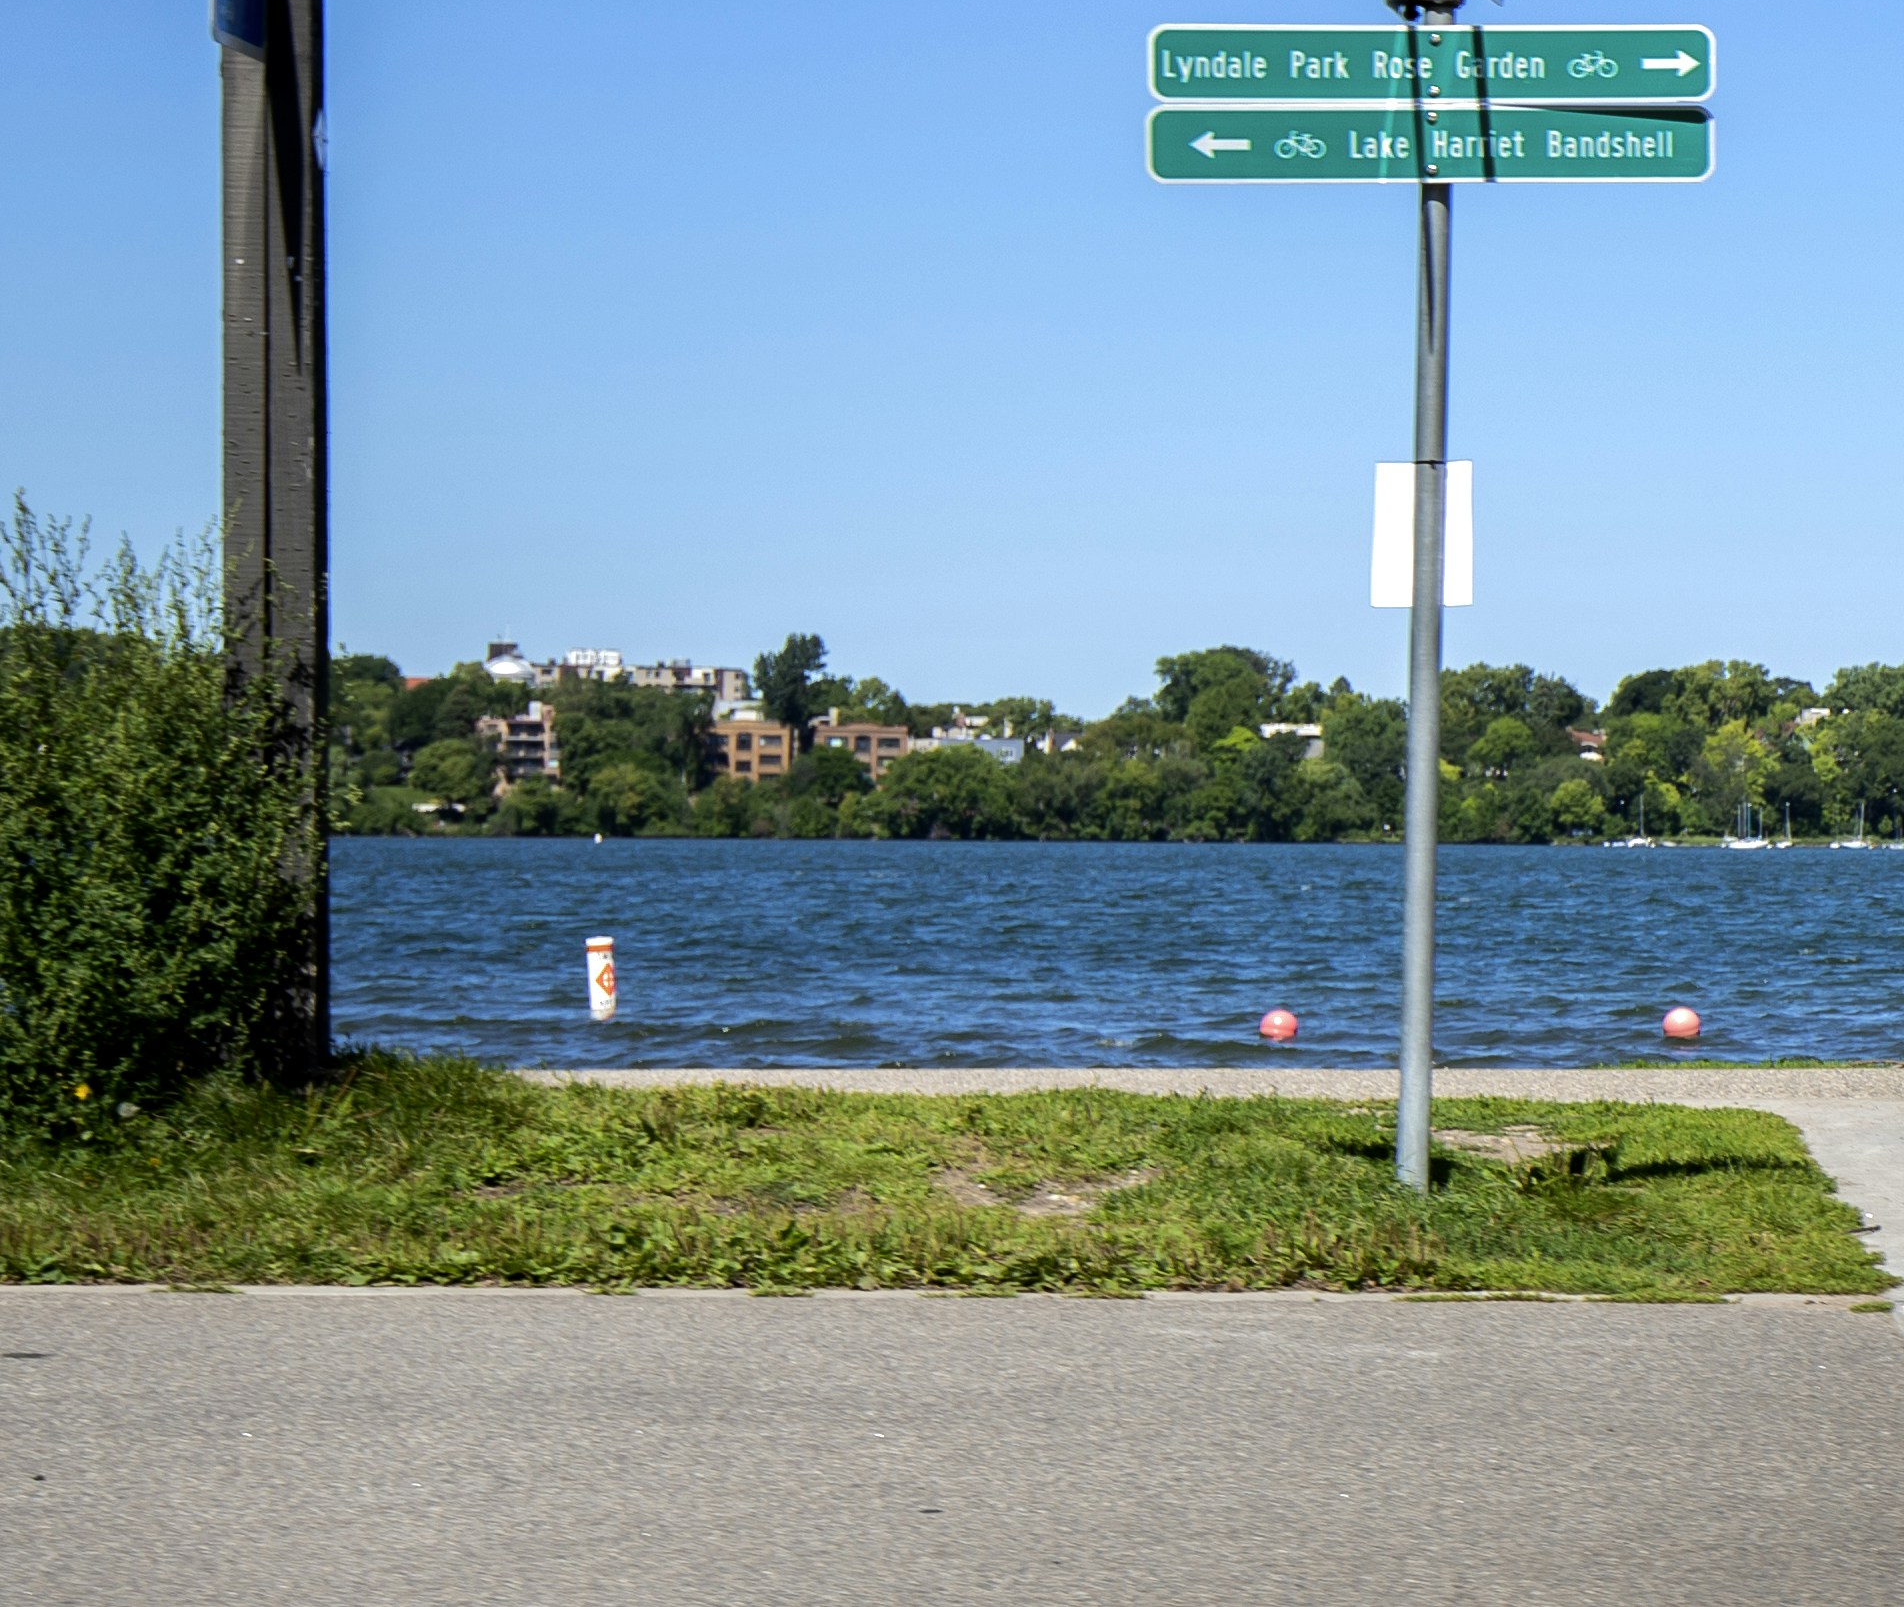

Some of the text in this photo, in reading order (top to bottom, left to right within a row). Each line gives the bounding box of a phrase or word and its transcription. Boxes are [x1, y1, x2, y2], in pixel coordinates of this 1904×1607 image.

[1160, 49, 1546, 84] Lyndale Park Rose Garden
[1347, 129, 1674, 160] Lake Harriet Bandshell
